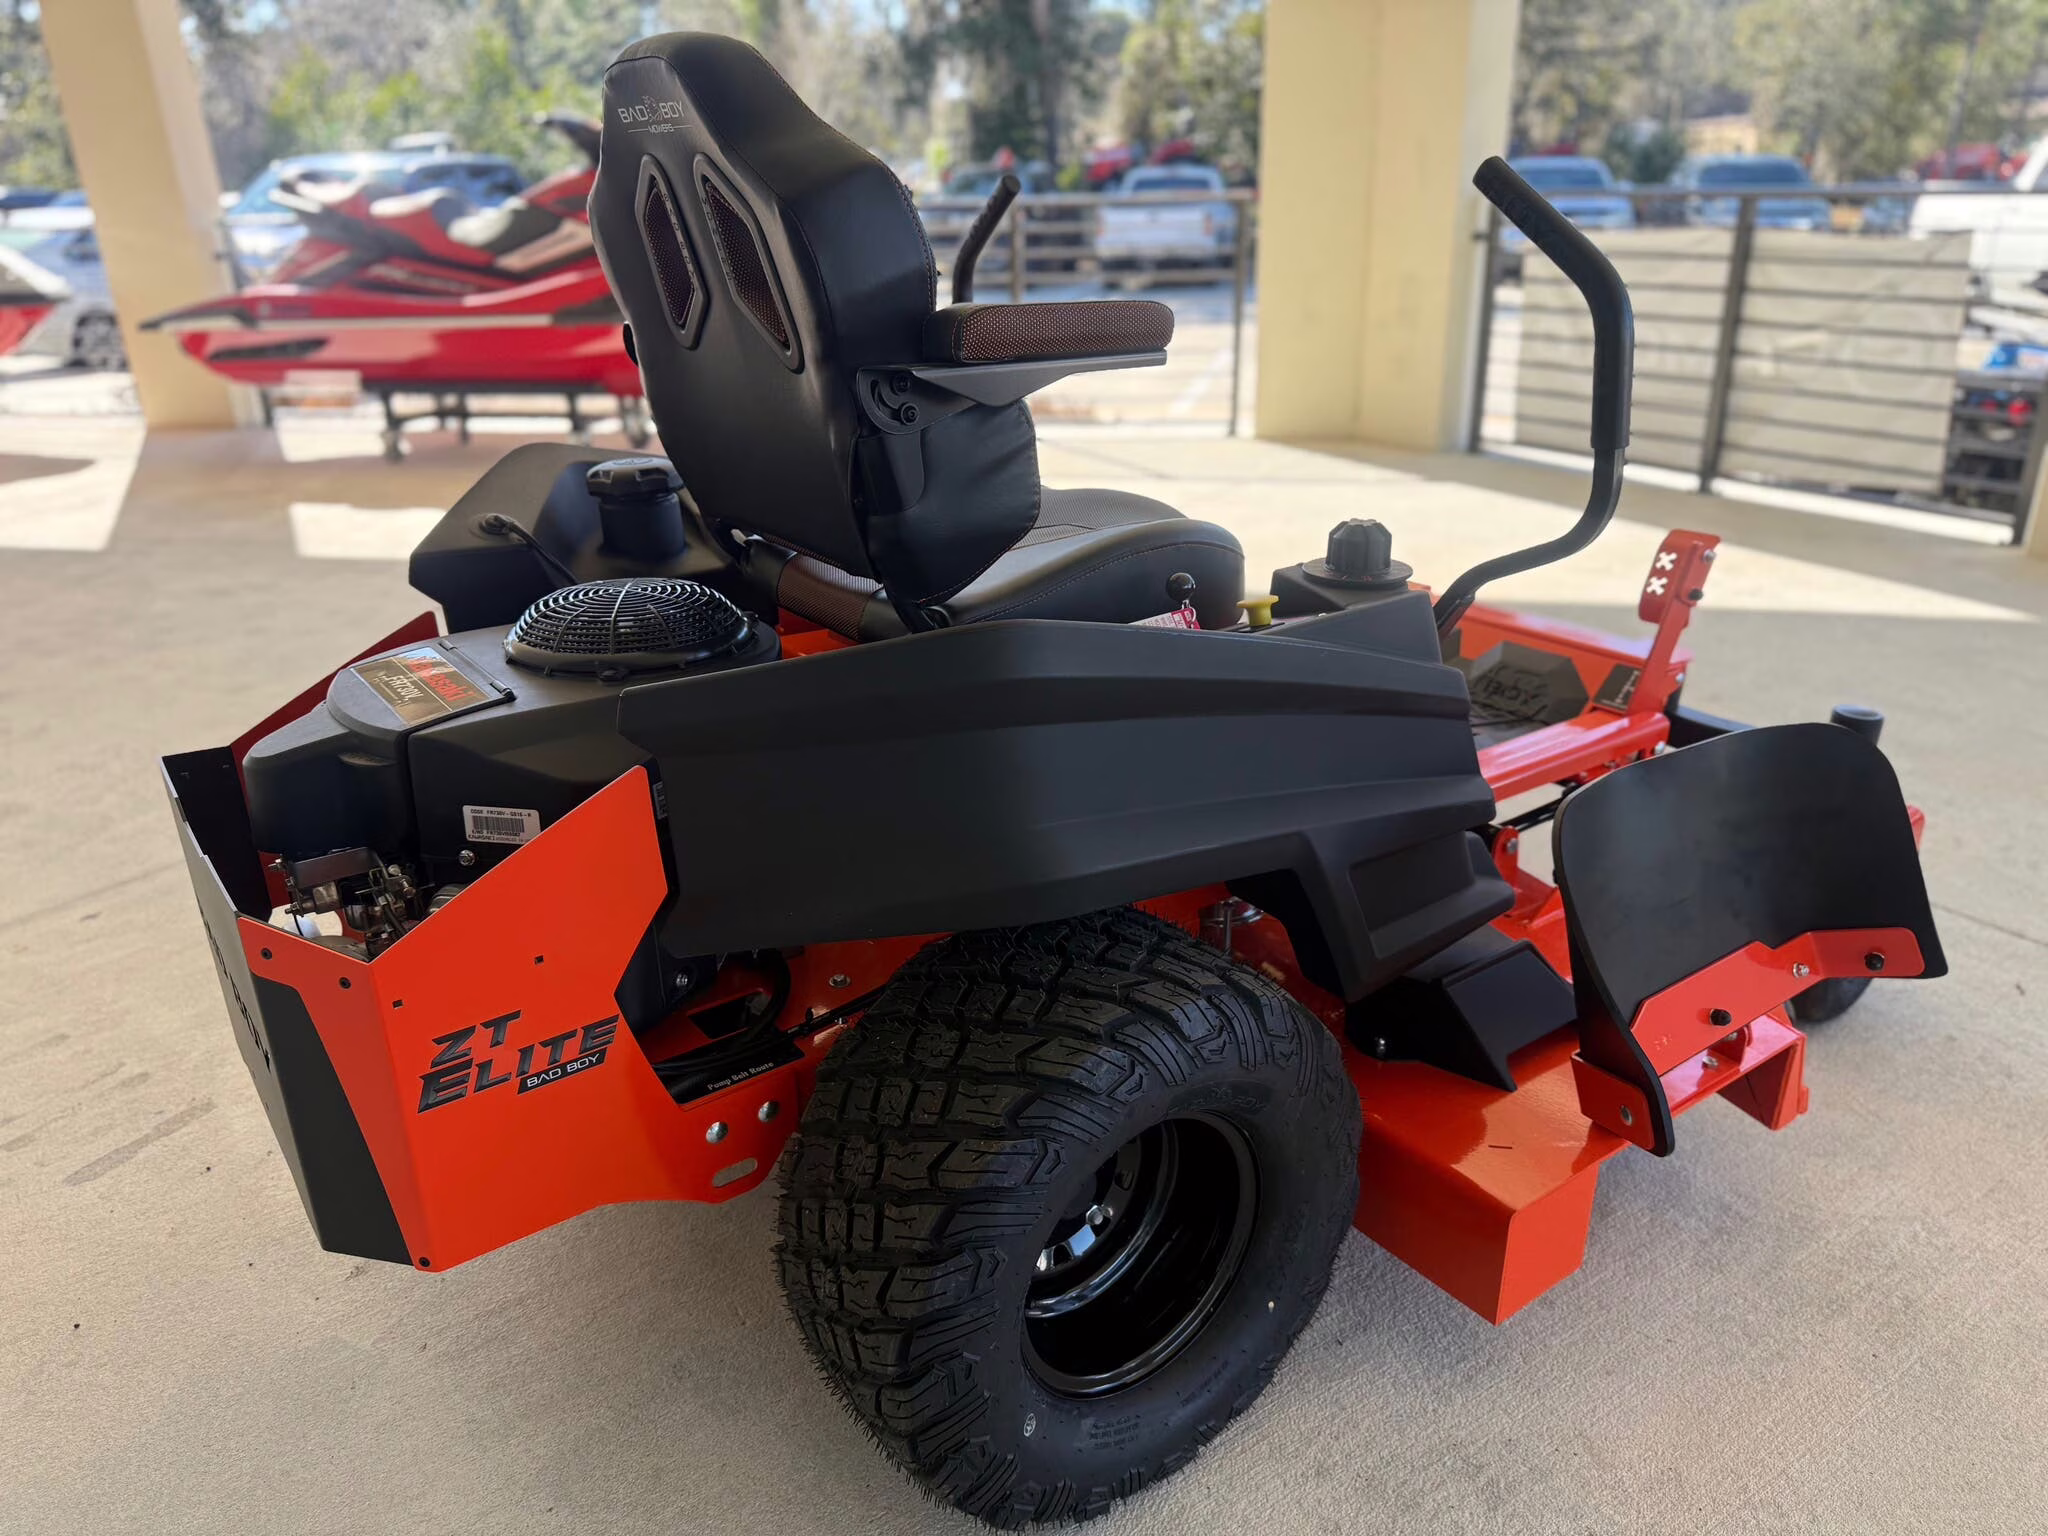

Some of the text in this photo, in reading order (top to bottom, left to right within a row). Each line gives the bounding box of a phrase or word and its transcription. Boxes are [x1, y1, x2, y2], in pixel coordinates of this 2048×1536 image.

[617, 101, 685, 123] BAD BOY
[430, 1009, 522, 1069] ZT
[417, 1014, 620, 1114] ELITE
[526, 1053, 600, 1087] BAD BOY
[707, 1062, 775, 1091] Pump Belt Route
